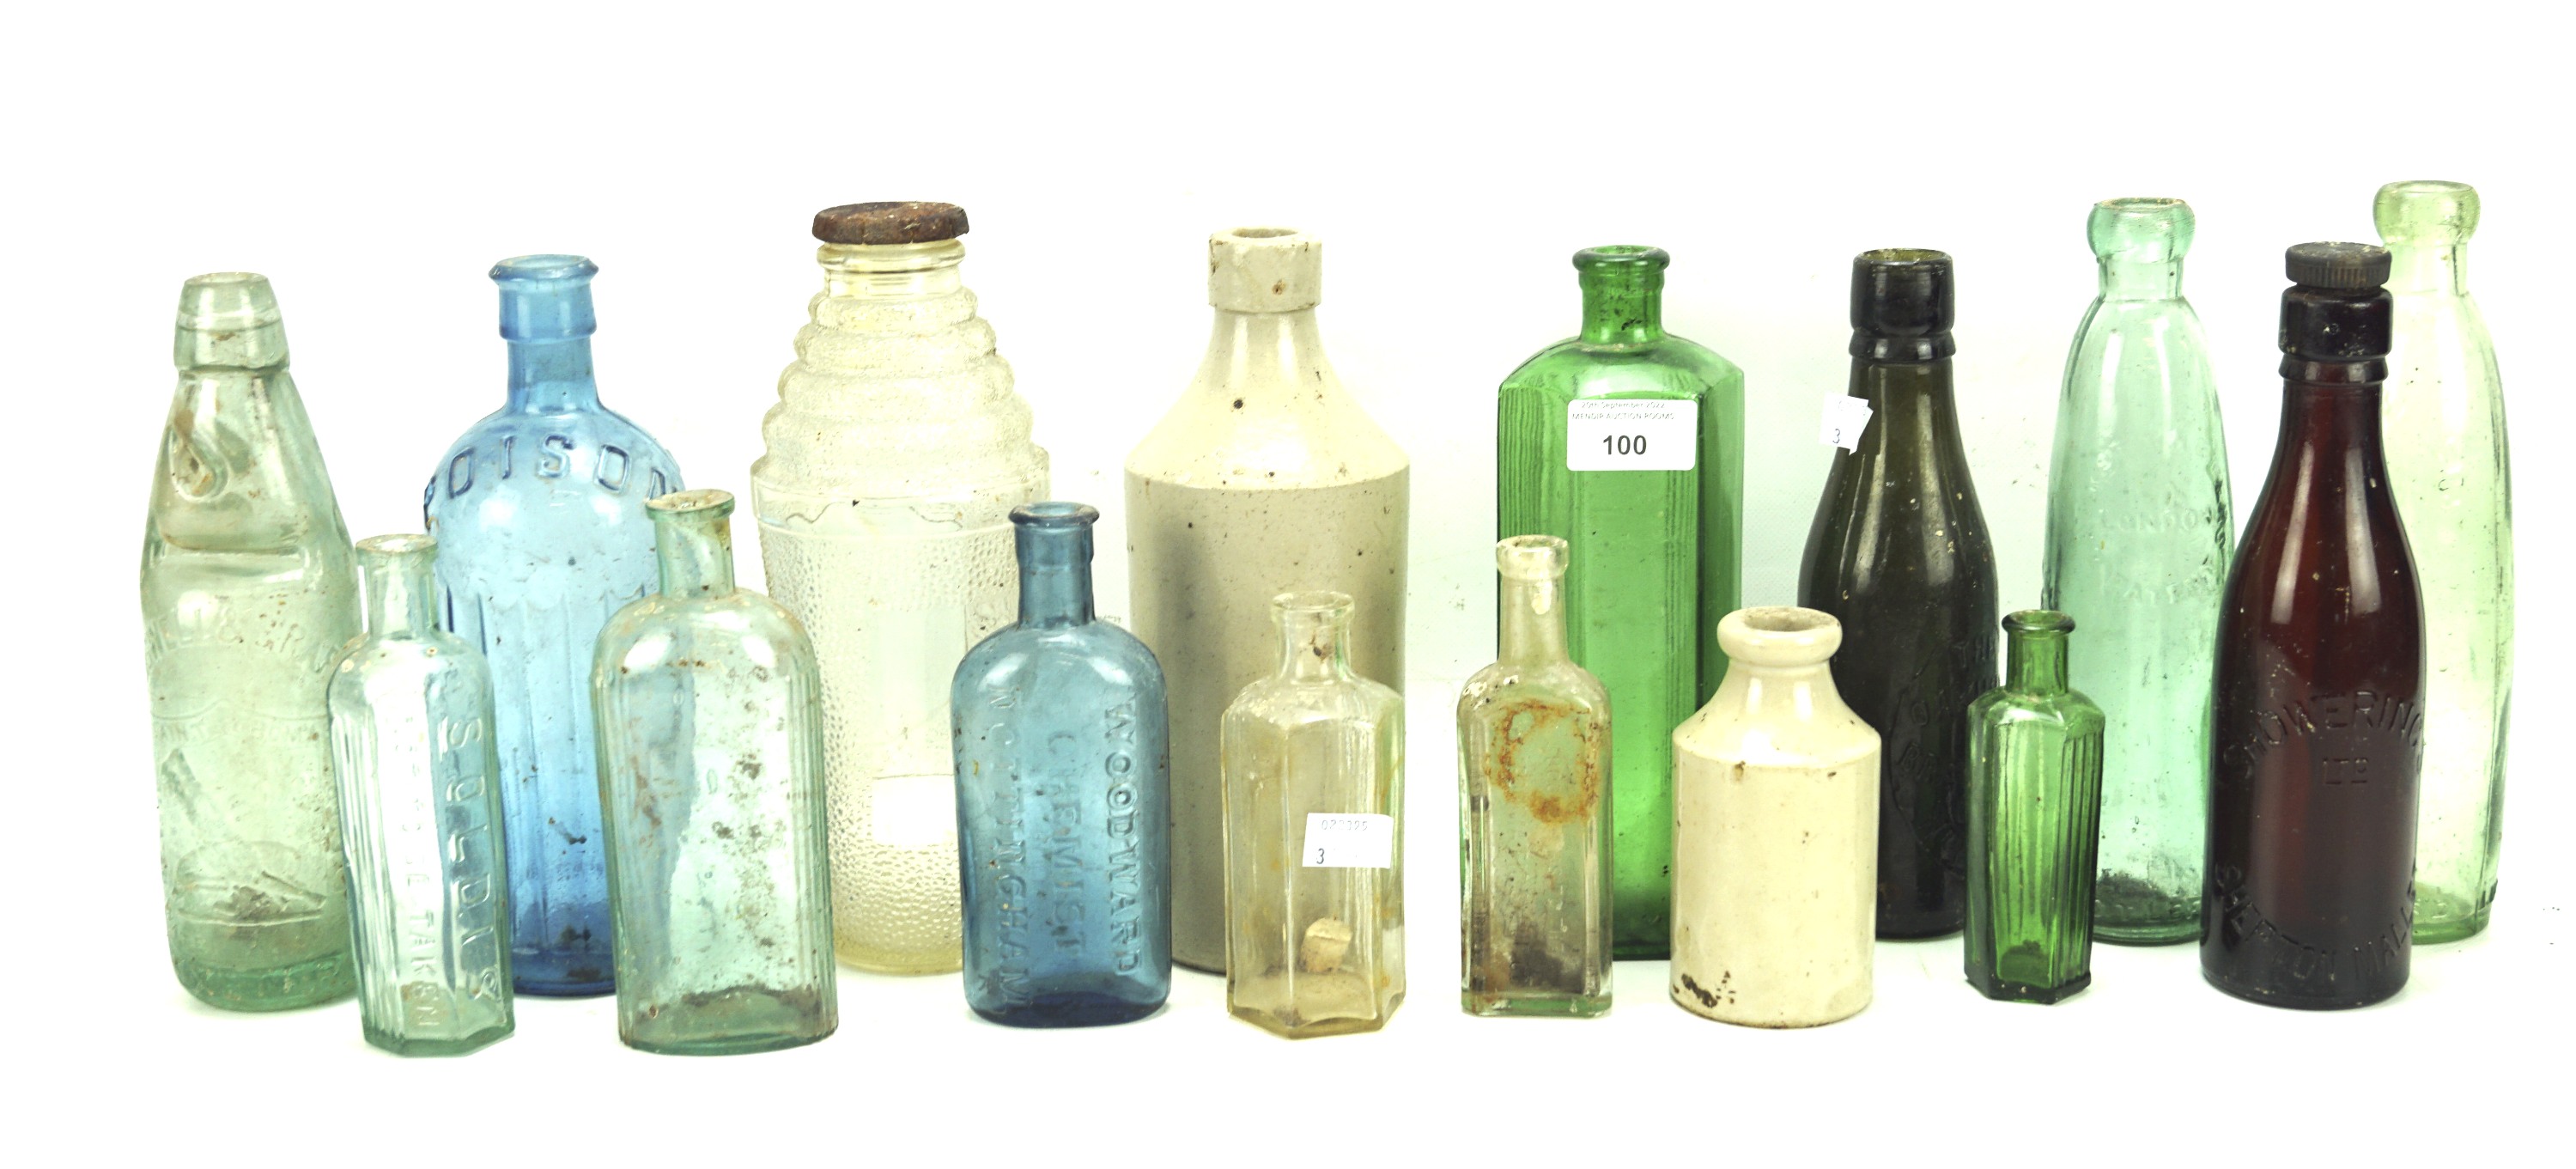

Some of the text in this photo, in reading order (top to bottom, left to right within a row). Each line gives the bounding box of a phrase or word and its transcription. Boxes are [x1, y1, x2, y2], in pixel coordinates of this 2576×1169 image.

[1603, 435, 1647, 455] 100
[1832, 428, 1841, 444] 3
[987, 686, 1030, 1008] NOTTINGHAM
[1047, 729, 1085, 960] CHEMIST
[1104, 692, 1143, 976] WOODWARD
[1315, 847, 1325, 865] 3
